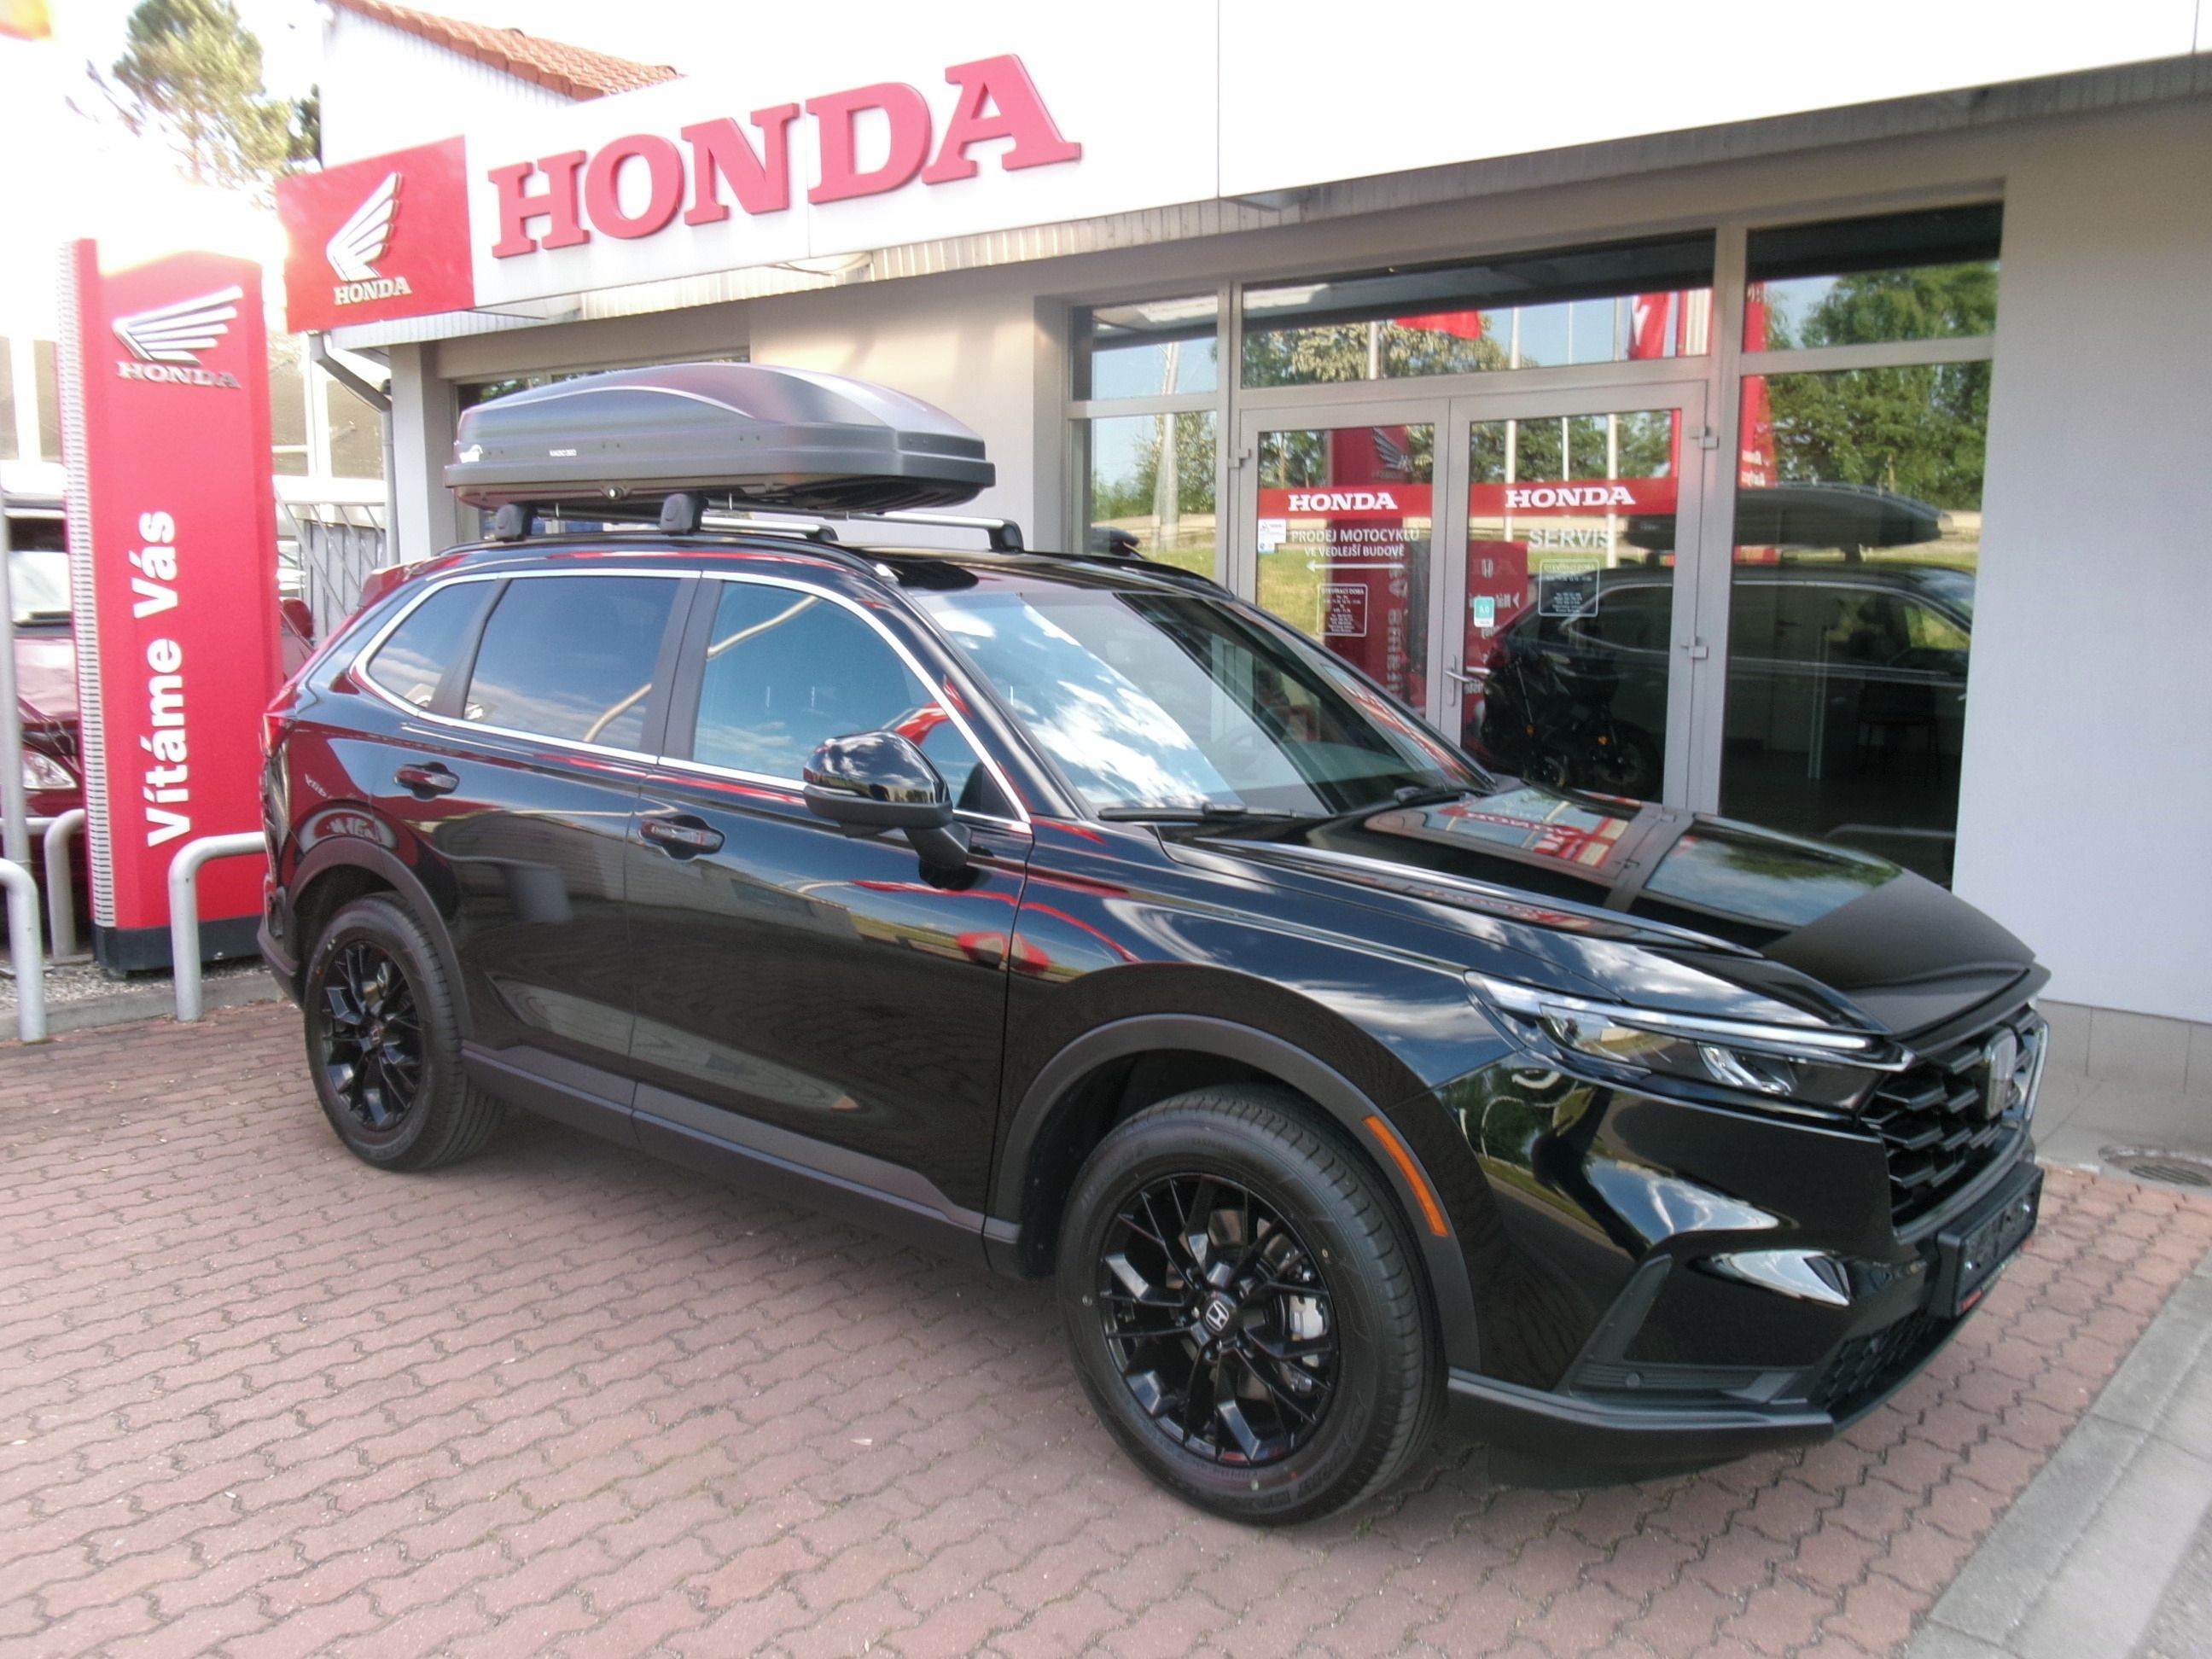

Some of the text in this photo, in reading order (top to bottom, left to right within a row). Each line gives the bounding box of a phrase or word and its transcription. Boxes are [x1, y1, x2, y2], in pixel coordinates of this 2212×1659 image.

[488, 53, 1081, 259] HONDA
[333, 276, 412, 306] HONDA
[116, 361, 242, 389] HONDA
[1288, 492, 1398, 512] HONDA
[1505, 486, 1637, 508] HONDA
[1291, 529, 1336, 543] PRODEJ
[1529, 528, 1611, 548] SERVIS
[1304, 543, 1405, 556] VE VEDLEJŠÍ BUDOVĚ
[128, 510, 191, 847] Vítáme Vás
